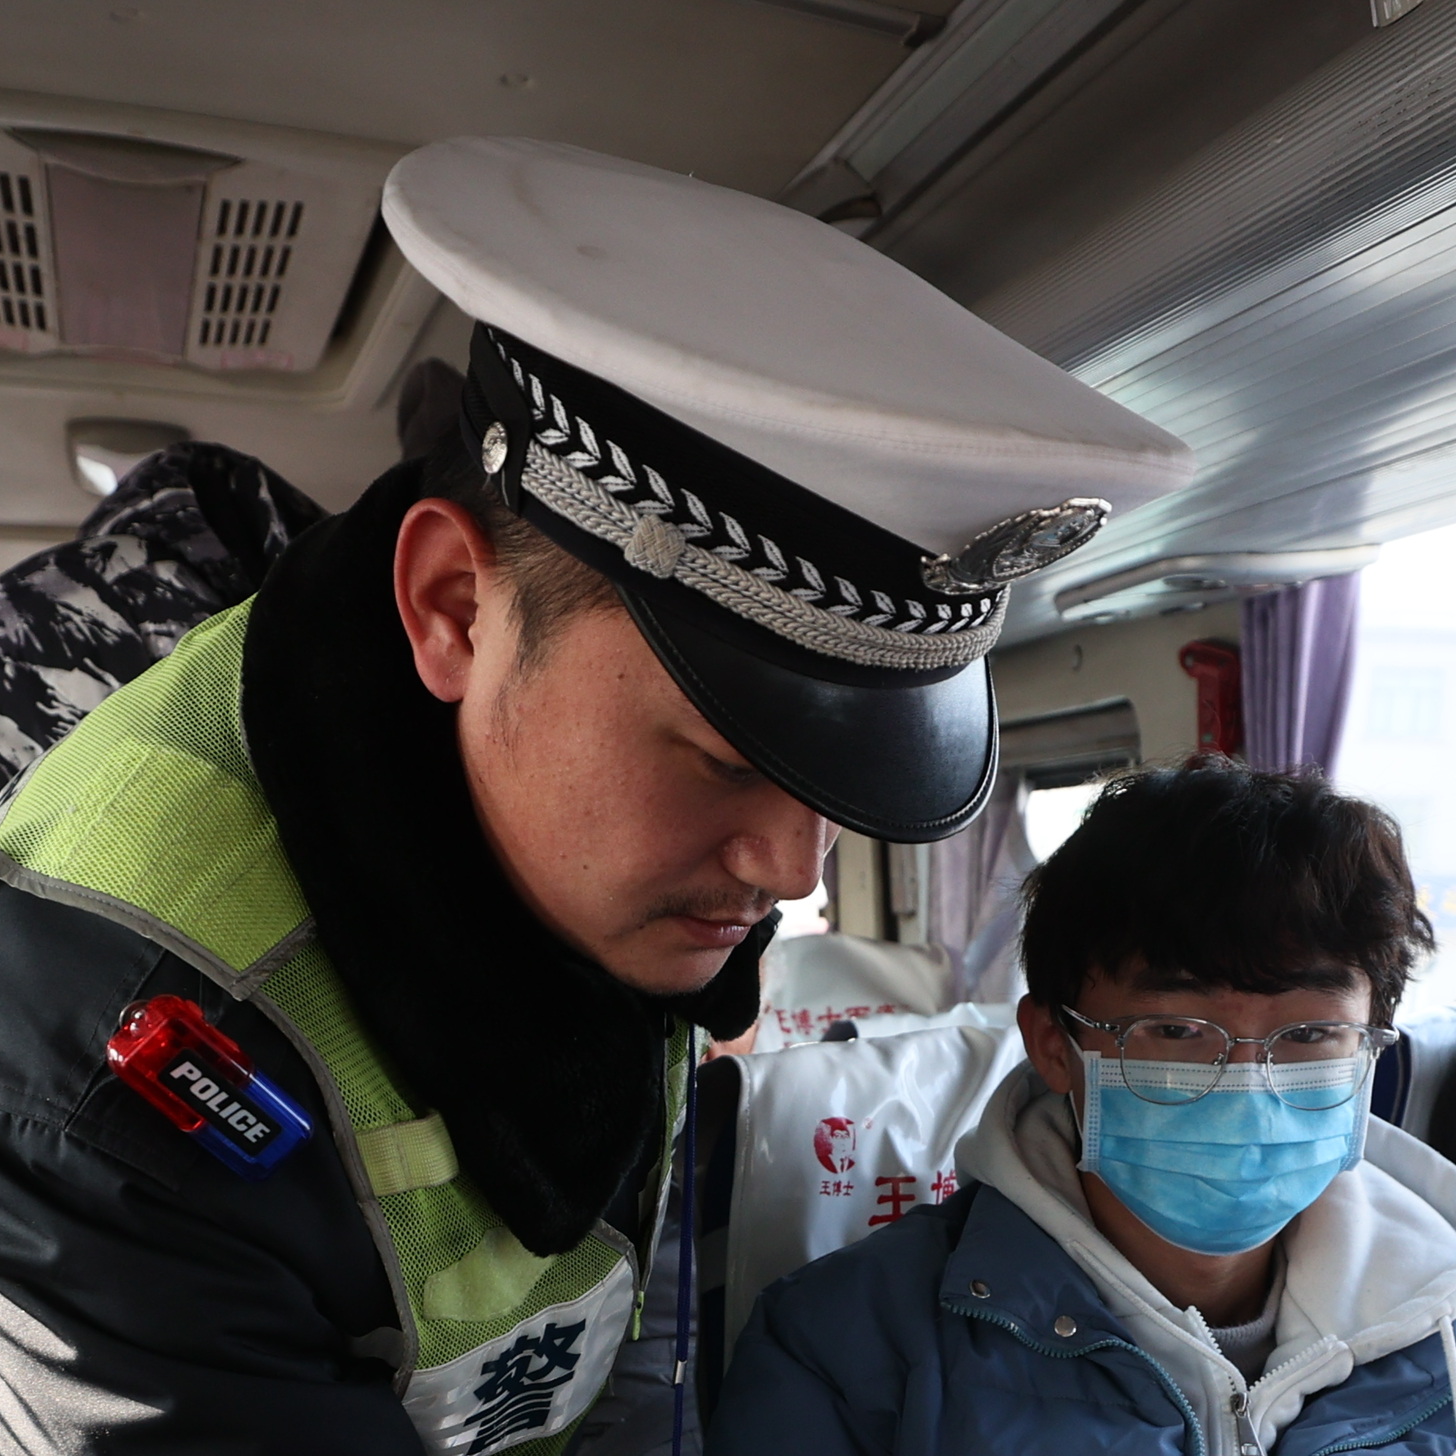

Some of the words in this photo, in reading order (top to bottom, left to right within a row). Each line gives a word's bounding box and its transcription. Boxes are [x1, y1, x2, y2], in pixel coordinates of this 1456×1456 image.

[169, 1060, 271, 1145] POLICE
[818, 1180, 854, 1197] 王博士
[464, 1318, 586, 1456] 警
